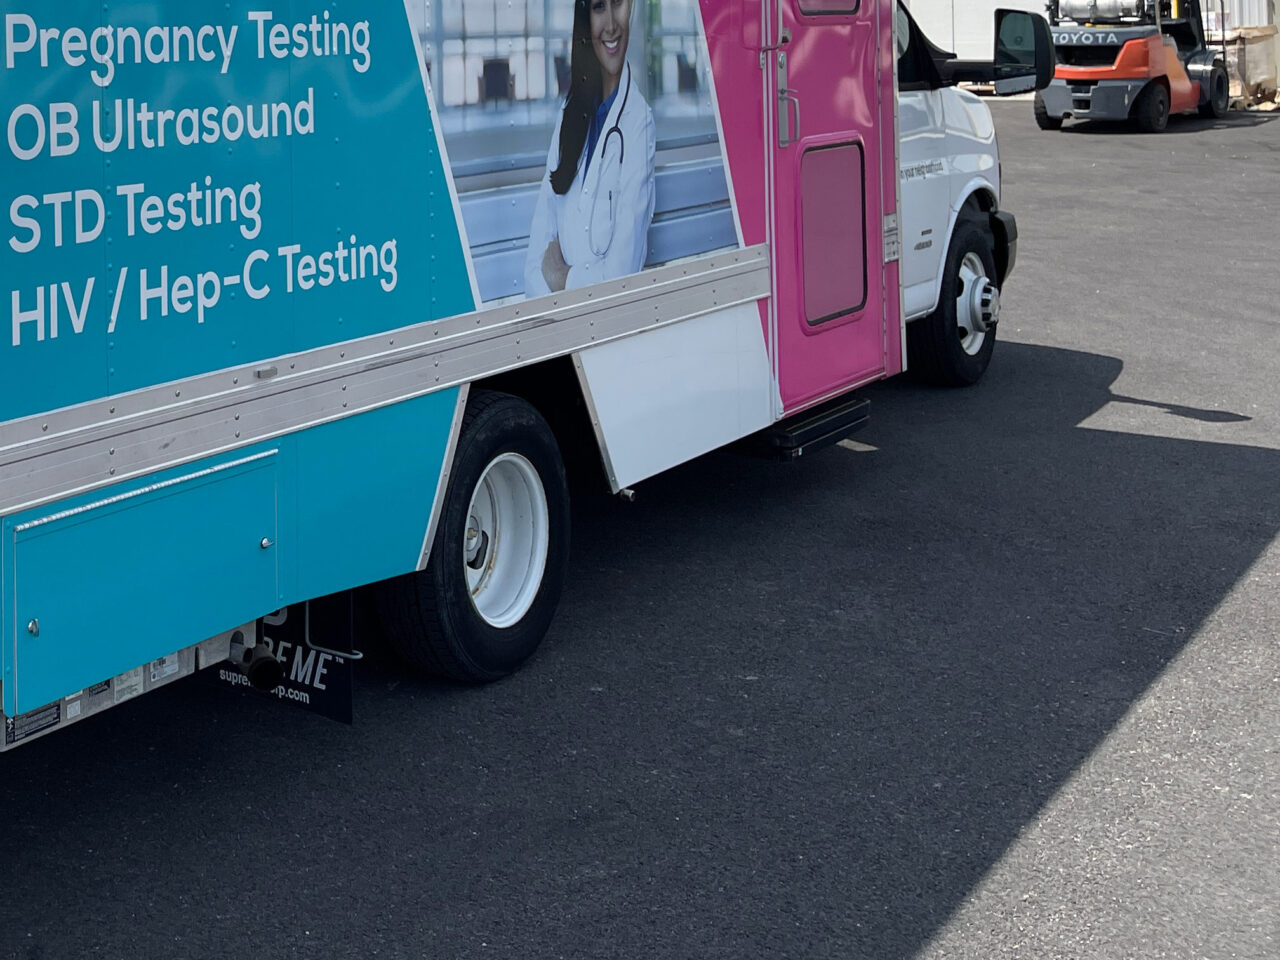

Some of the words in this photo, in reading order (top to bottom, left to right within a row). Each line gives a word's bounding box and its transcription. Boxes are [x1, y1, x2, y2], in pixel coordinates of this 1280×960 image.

[5, 13, 239, 87] Pregnancy
[248, 10, 372, 73] Testing
[1052, 32, 1118, 45] TOYOTA
[7, 102, 81, 161] OB
[92, 87, 316, 153] Ultrasound
[8, 189, 105, 254] STD
[117, 176, 262, 240] Testing
[11, 277, 96, 347] HIV
[140, 249, 271, 324] Hep-C
[278, 234, 399, 293] Testing
